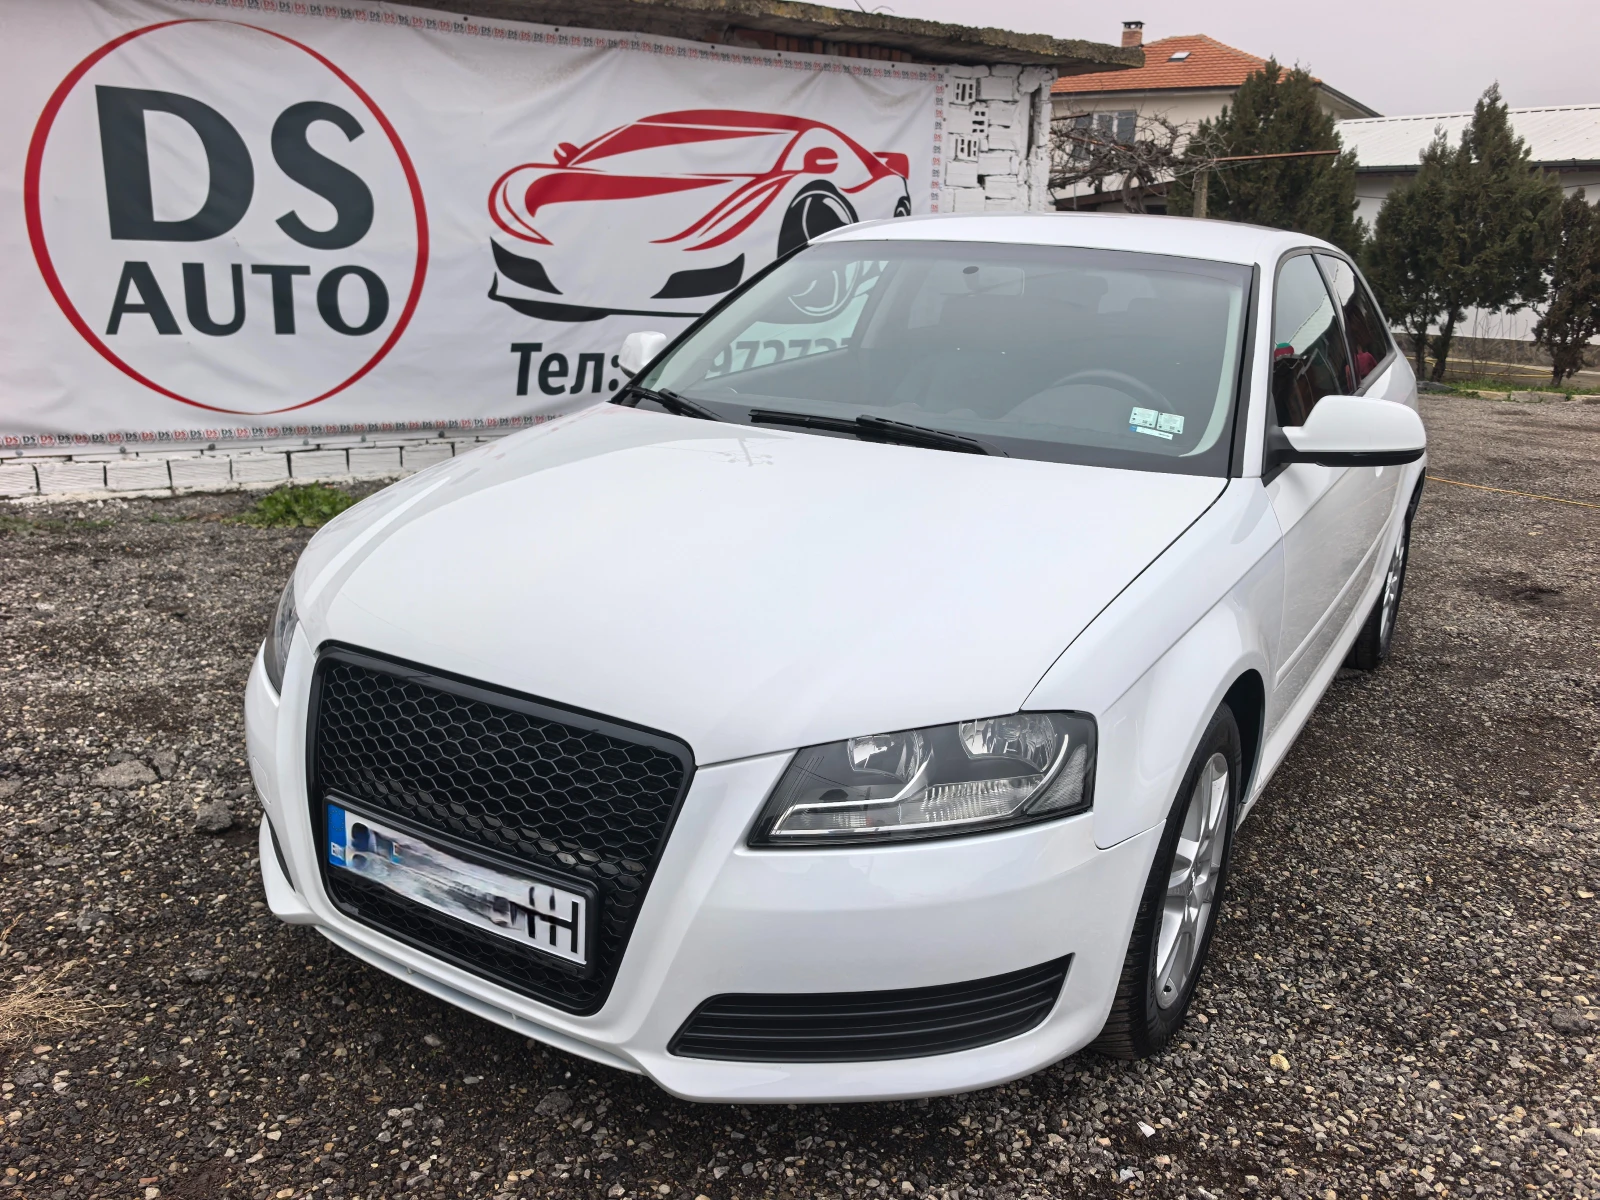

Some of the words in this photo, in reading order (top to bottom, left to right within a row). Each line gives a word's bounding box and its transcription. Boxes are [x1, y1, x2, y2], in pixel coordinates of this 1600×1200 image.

[95, 85, 374, 250] DS
[105, 261, 390, 336] AUTO
[510, 342, 620, 396] Тел:
